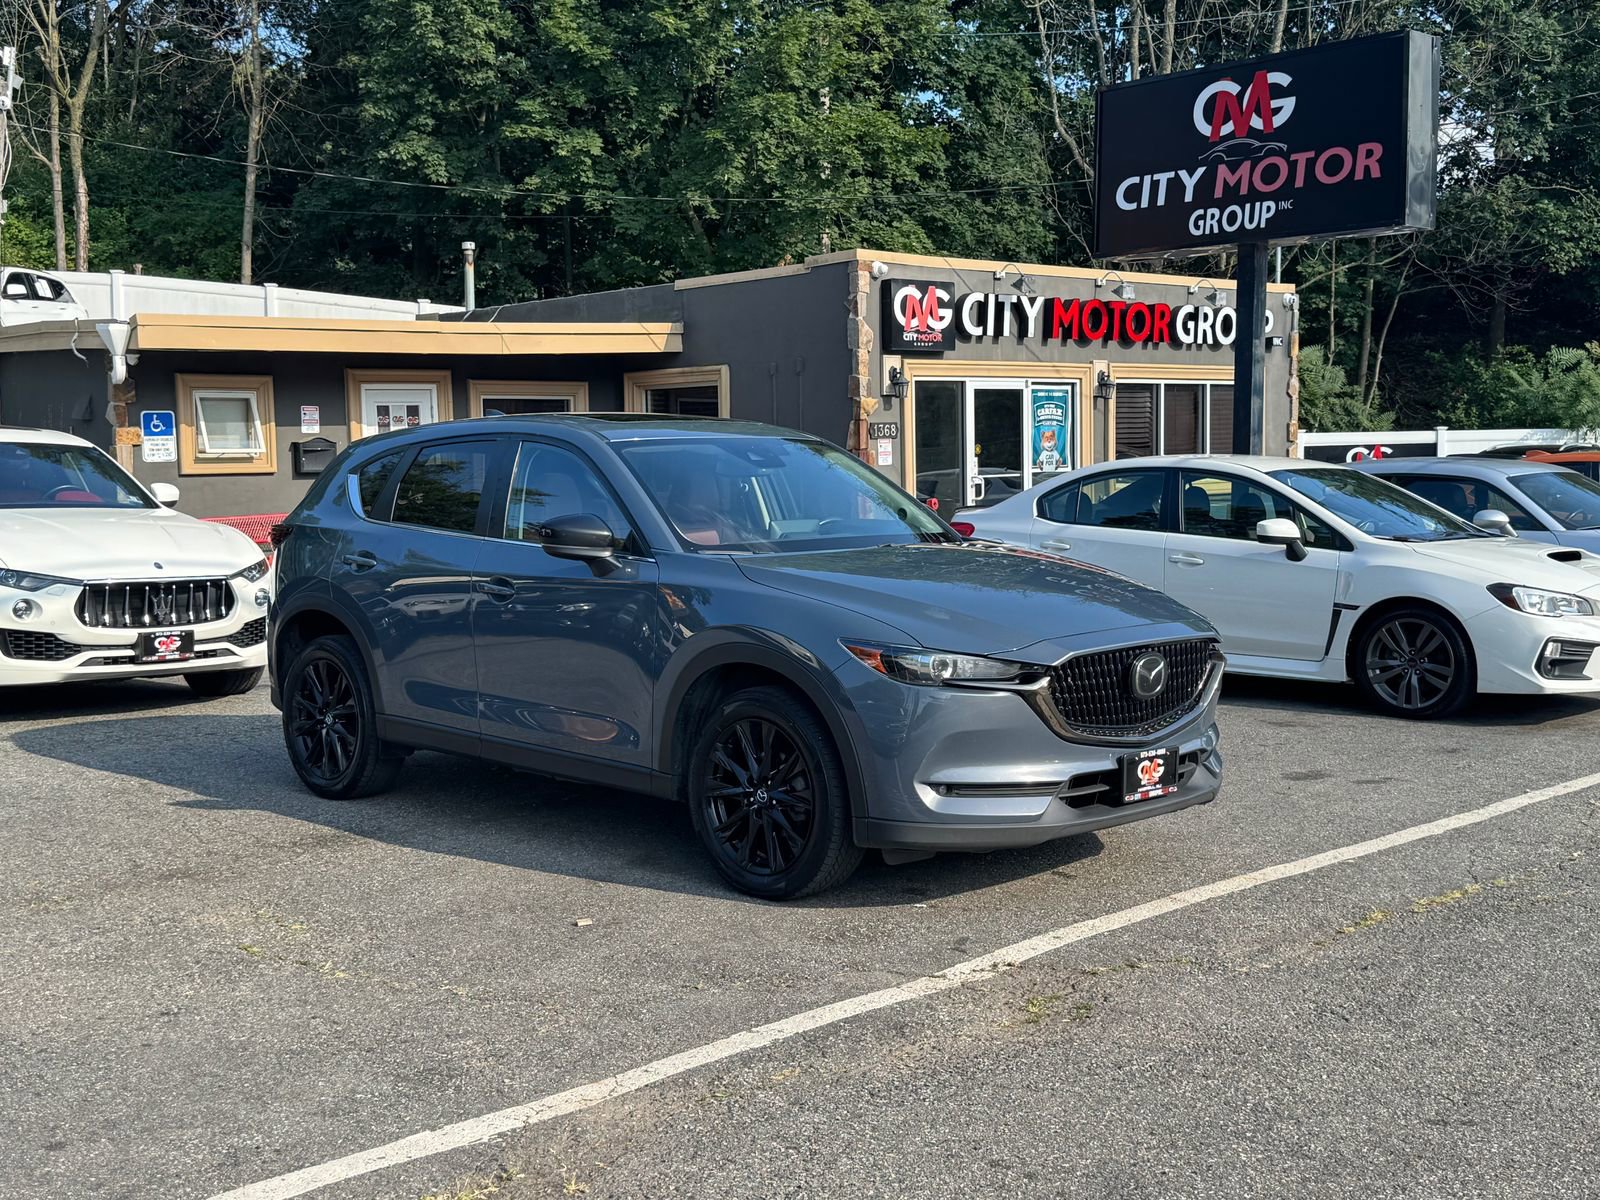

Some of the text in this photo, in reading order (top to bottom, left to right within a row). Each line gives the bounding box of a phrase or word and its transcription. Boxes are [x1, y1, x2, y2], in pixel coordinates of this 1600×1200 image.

[1115, 142, 1383, 211] CITY MOTOR
[1188, 200, 1294, 236] GROUP INC
[961, 292, 1274, 346] CITY MOTOR GROP
[903, 333, 943, 342] CITY MOTOR
[874, 424, 896, 437] 1368
